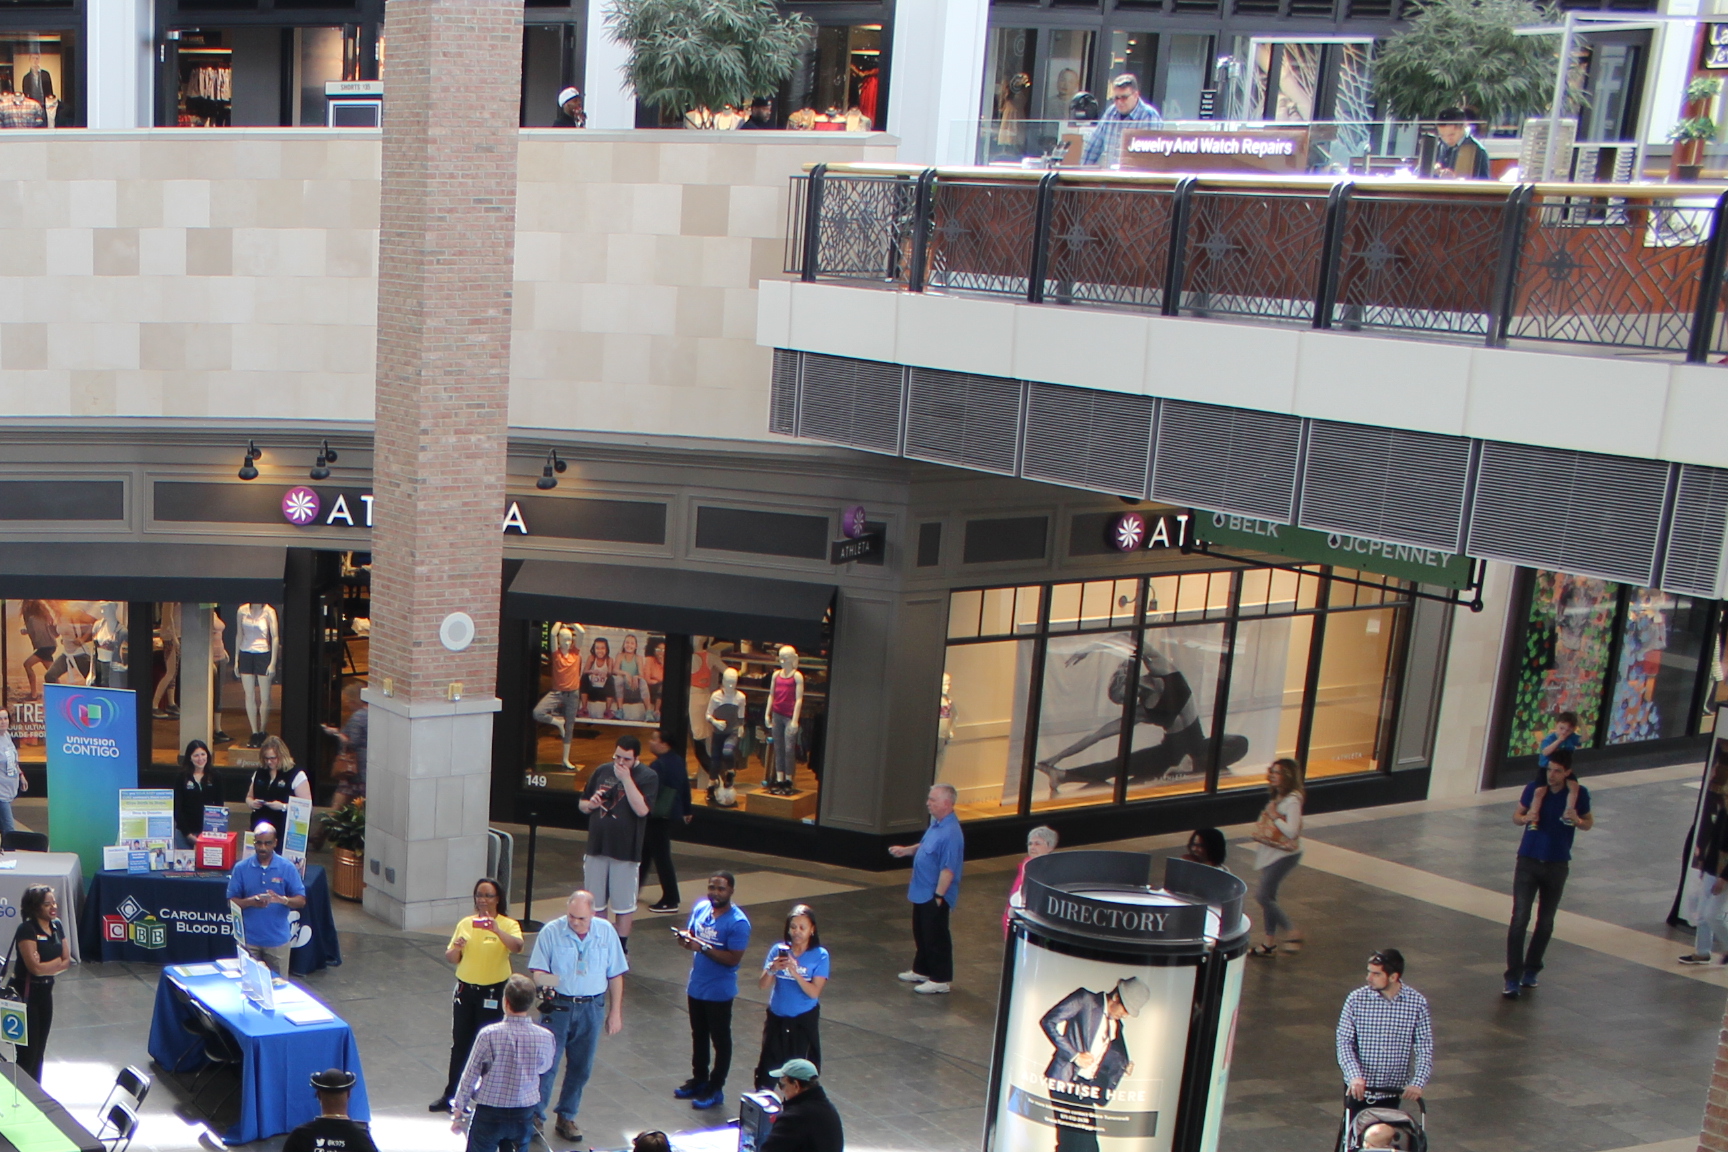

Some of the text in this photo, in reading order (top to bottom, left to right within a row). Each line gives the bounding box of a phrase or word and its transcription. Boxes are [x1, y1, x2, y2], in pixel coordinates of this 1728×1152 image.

[1709, 24, 1728, 45] La
[1706, 47, 1728, 65] Je
[1128, 137, 1293, 158] Jewelry And Watch Repairs
[1229, 515, 1279, 538] BELK
[1343, 535, 1451, 569] JCPENNEY
[14, 703, 44, 723] TRE
[62, 743, 120, 758] CONTIGO
[526, 774, 547, 787] 149
[127, 904, 136, 915] C
[159, 908, 233, 923] CAROLINAS
[1047, 896, 1170, 932] DIRECTORY
[111, 925, 164, 943] C B B
[176, 921, 234, 935] BLOOD BA
[7, 1016, 19, 1036] 2
[1022, 1071, 1147, 1102] ADVERTISE HERE
